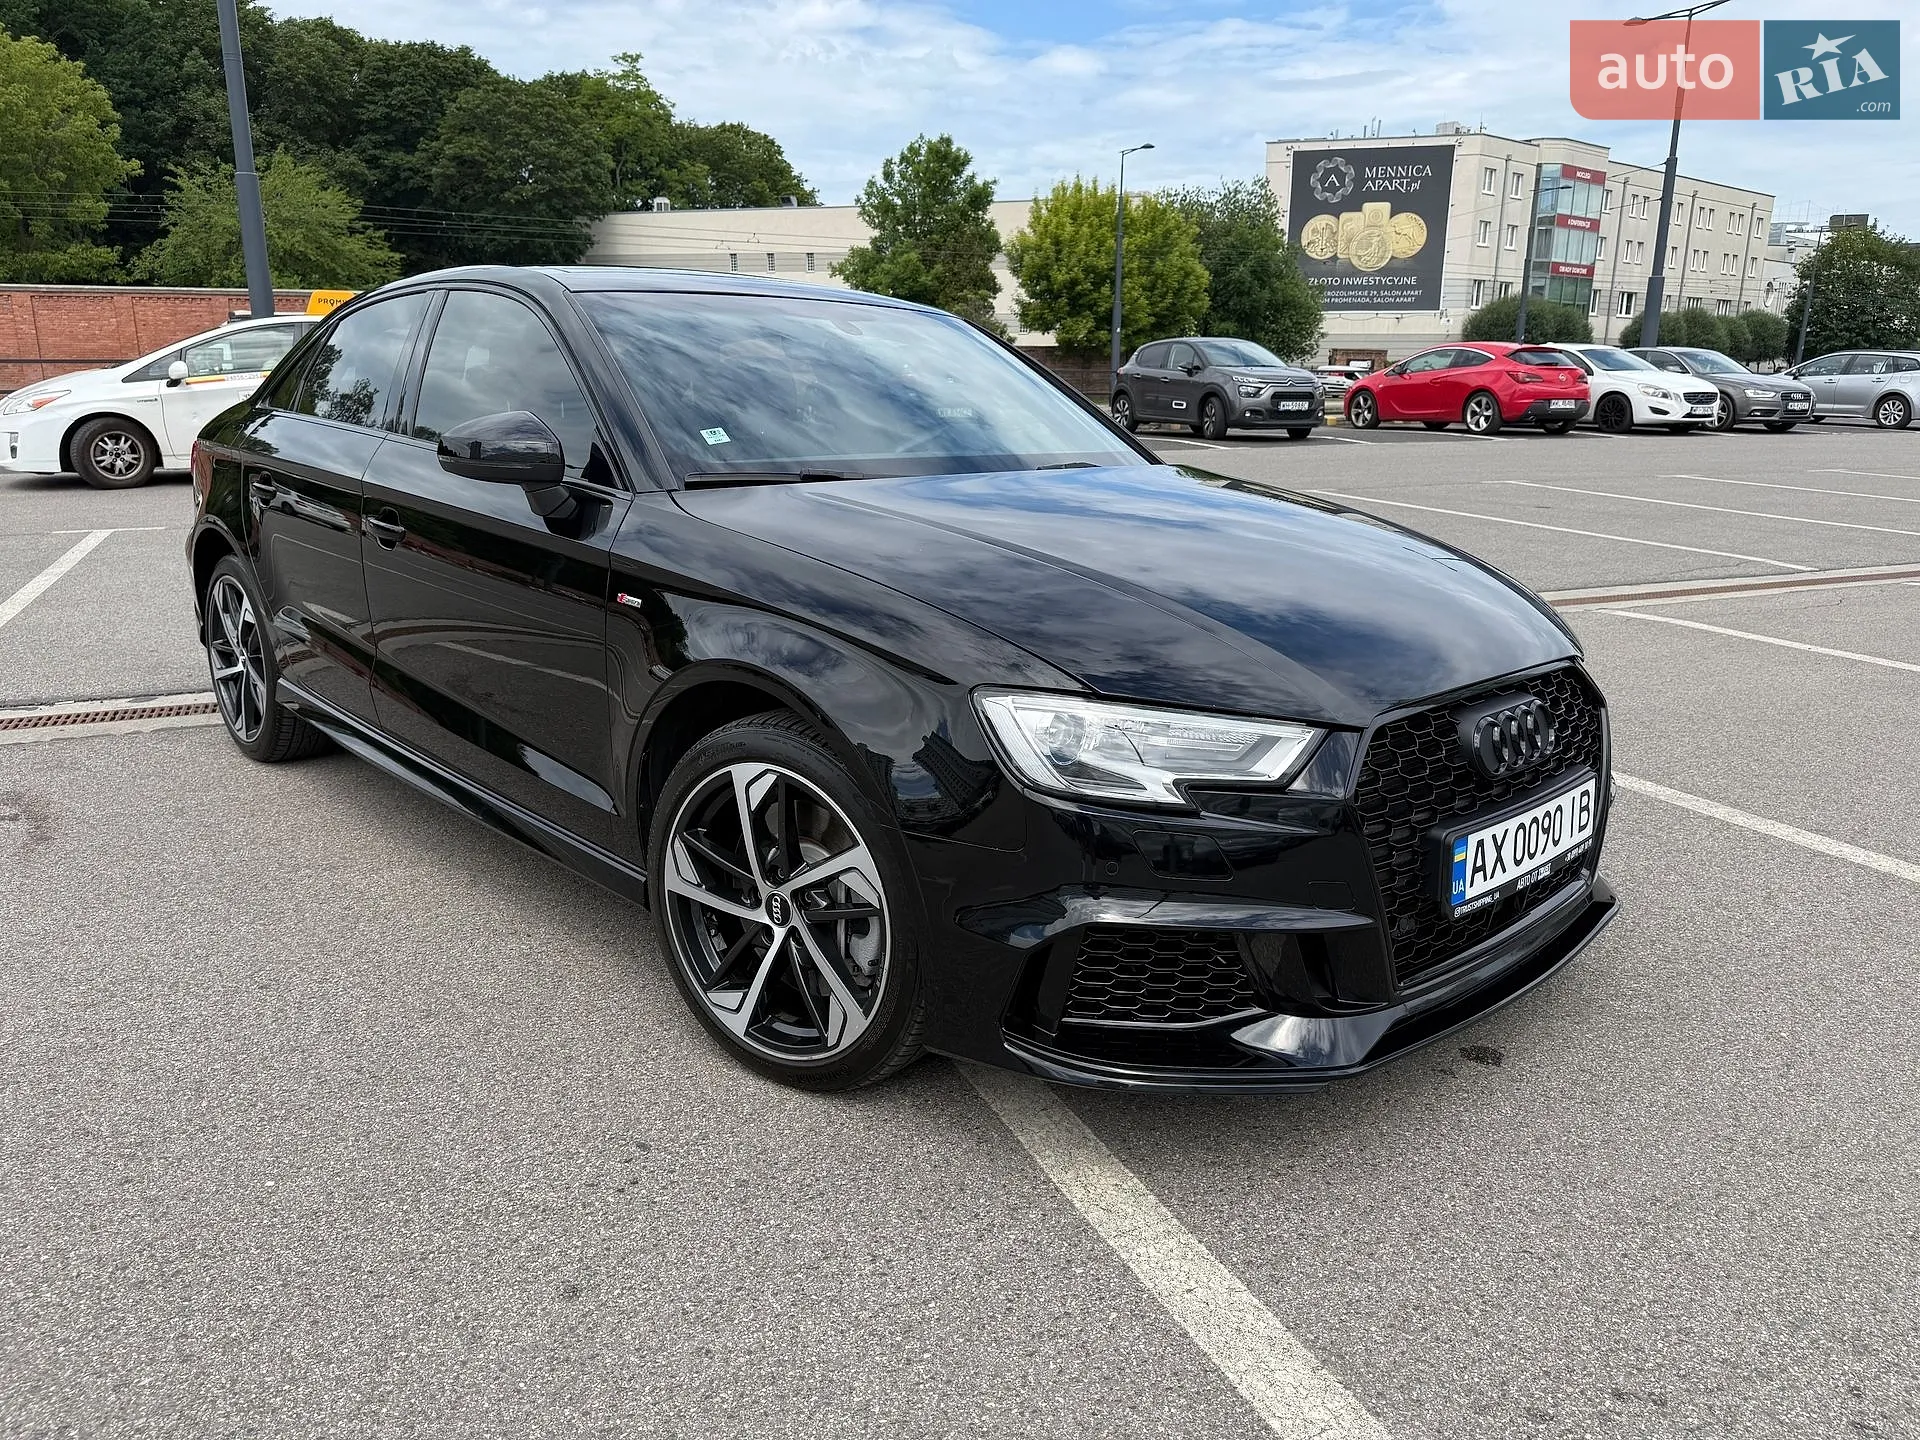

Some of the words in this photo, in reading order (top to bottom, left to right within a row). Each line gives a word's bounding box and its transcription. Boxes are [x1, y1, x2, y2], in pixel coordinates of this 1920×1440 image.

[1364, 165, 1432, 178] MENNICA
[1362, 179, 1421, 193] APART.pl
[1342, 276, 1417, 285] INWESTYCYJNE
[317, 297, 345, 307] PROM
[1469, 828, 1509, 889] AX
[1513, 804, 1563, 867] 0090
[1569, 789, 1591, 839] IB
[1452, 881, 1465, 895] UA
